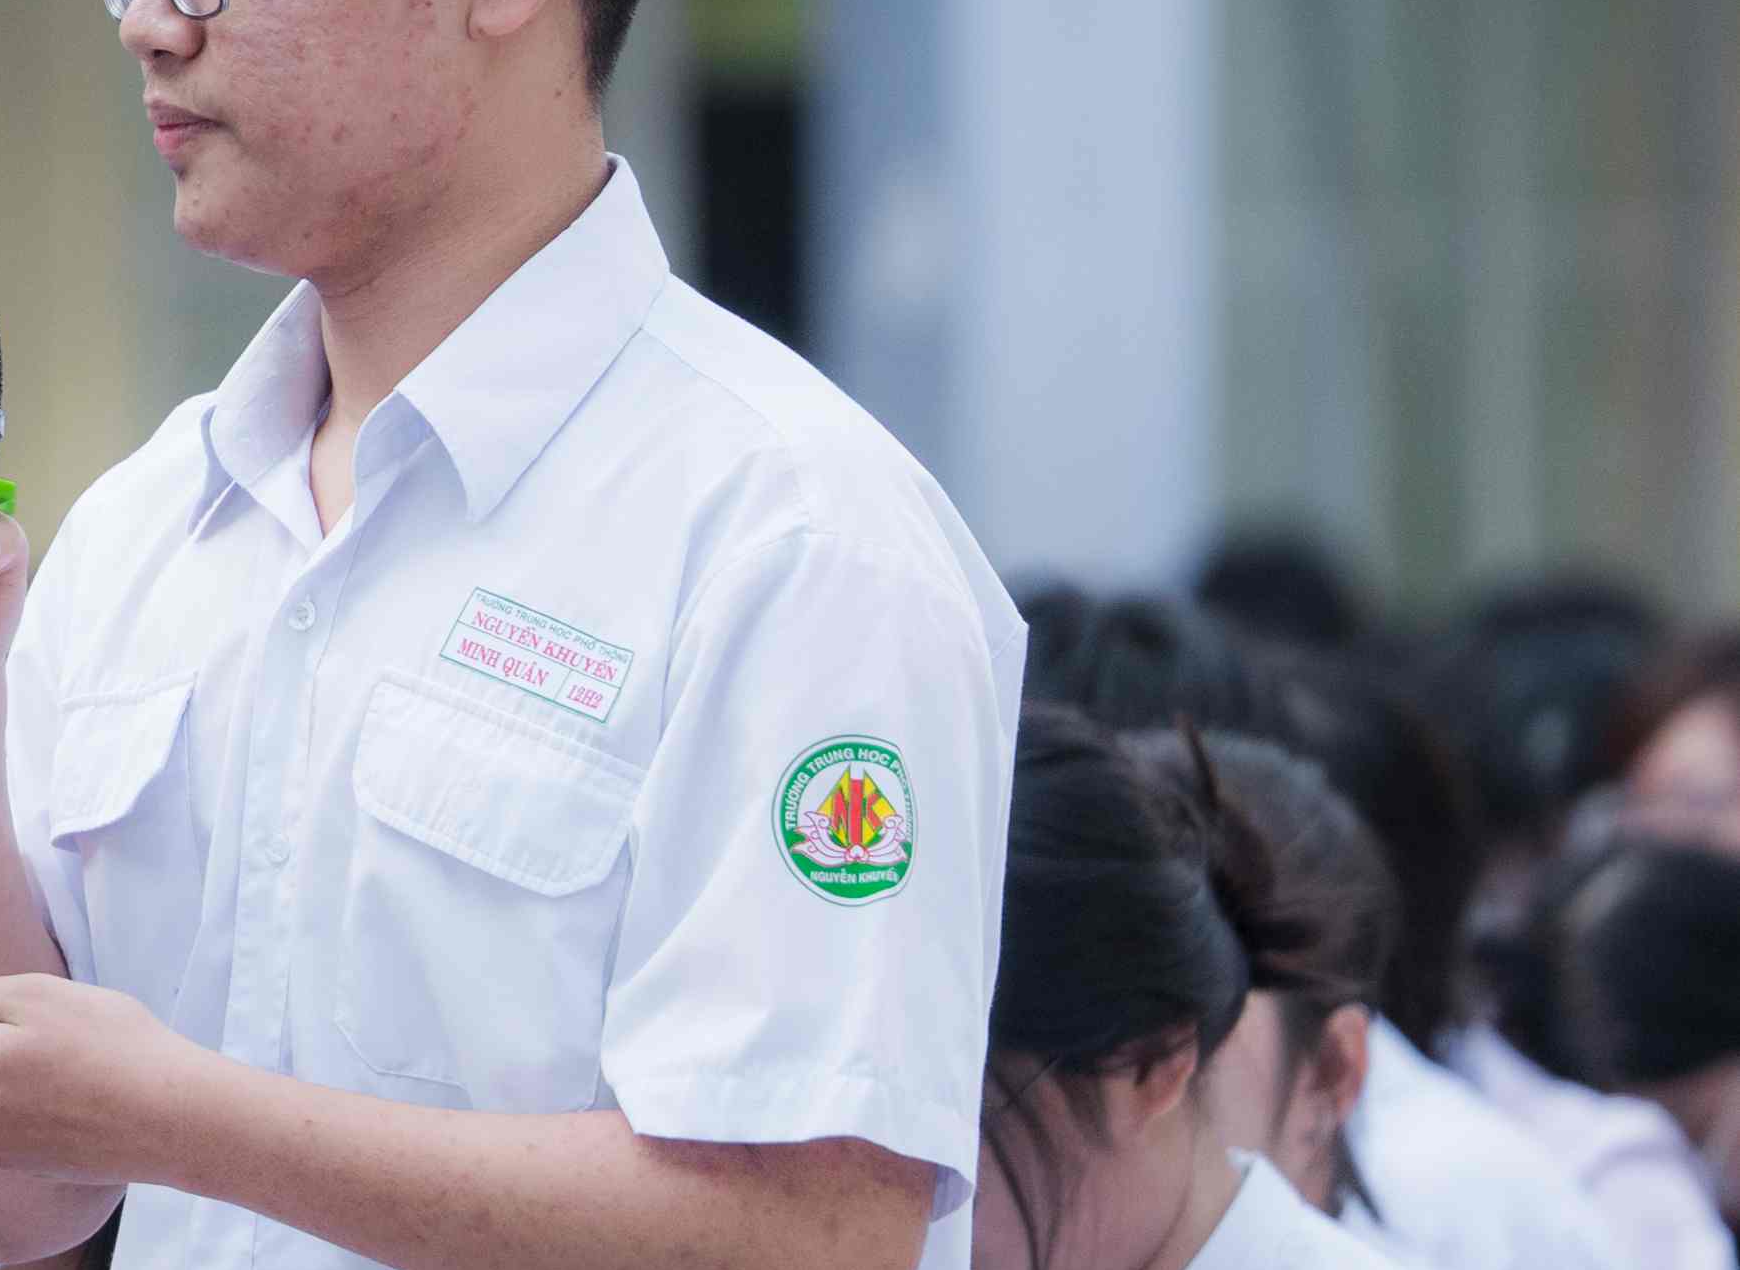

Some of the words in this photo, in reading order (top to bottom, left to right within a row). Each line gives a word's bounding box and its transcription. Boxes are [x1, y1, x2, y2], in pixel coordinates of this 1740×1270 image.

[458, 638, 501, 667] MINH
[503, 657, 549, 686] QUÂN
[567, 684, 603, 709] 12H2
[807, 747, 855, 775] TRUNG
